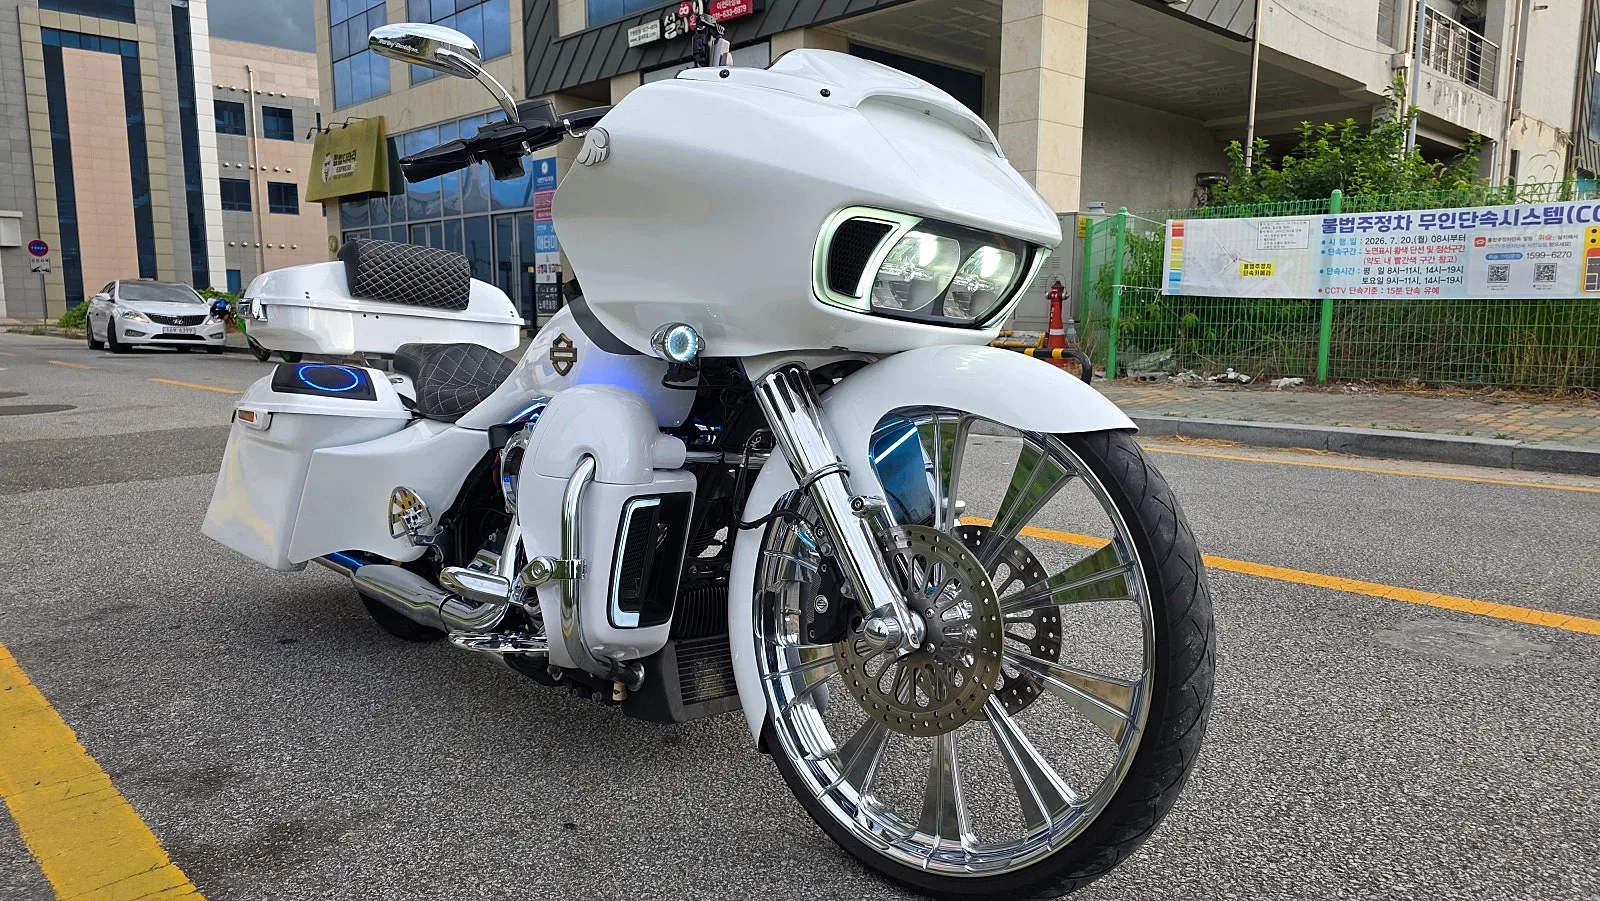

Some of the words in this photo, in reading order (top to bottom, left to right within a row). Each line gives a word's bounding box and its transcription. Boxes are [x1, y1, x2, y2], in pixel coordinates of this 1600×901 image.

[1321, 215, 1413, 234] 불법주정차
[1365, 237, 1387, 245] 2026.
[1390, 237, 1398, 245] 7.
[1431, 234, 1466, 244] 08시부터
[1328, 248, 1356, 256] 단속구간
[1364, 246, 1392, 255] 노면표시
[1410, 246, 1426, 254] 단선
[1526, 251, 1572, 259] 1599-6270
[1363, 257, 1380, 265] (약도
[1383, 256, 1391, 264] 내
[1394, 256, 1417, 265] 빨간색
[1419, 256, 1435, 264] 구간
[1438, 255, 1458, 264] 참고)
[1326, 267, 1354, 275] 단속시간
[1377, 267, 1385, 275] 일
[1361, 277, 1384, 285] 토요일
[1349, 287, 1379, 295] 단속기준
[1387, 287, 1403, 295] 15분
[1405, 287, 1421, 295] 단속
[1424, 287, 1440, 295] 유예
